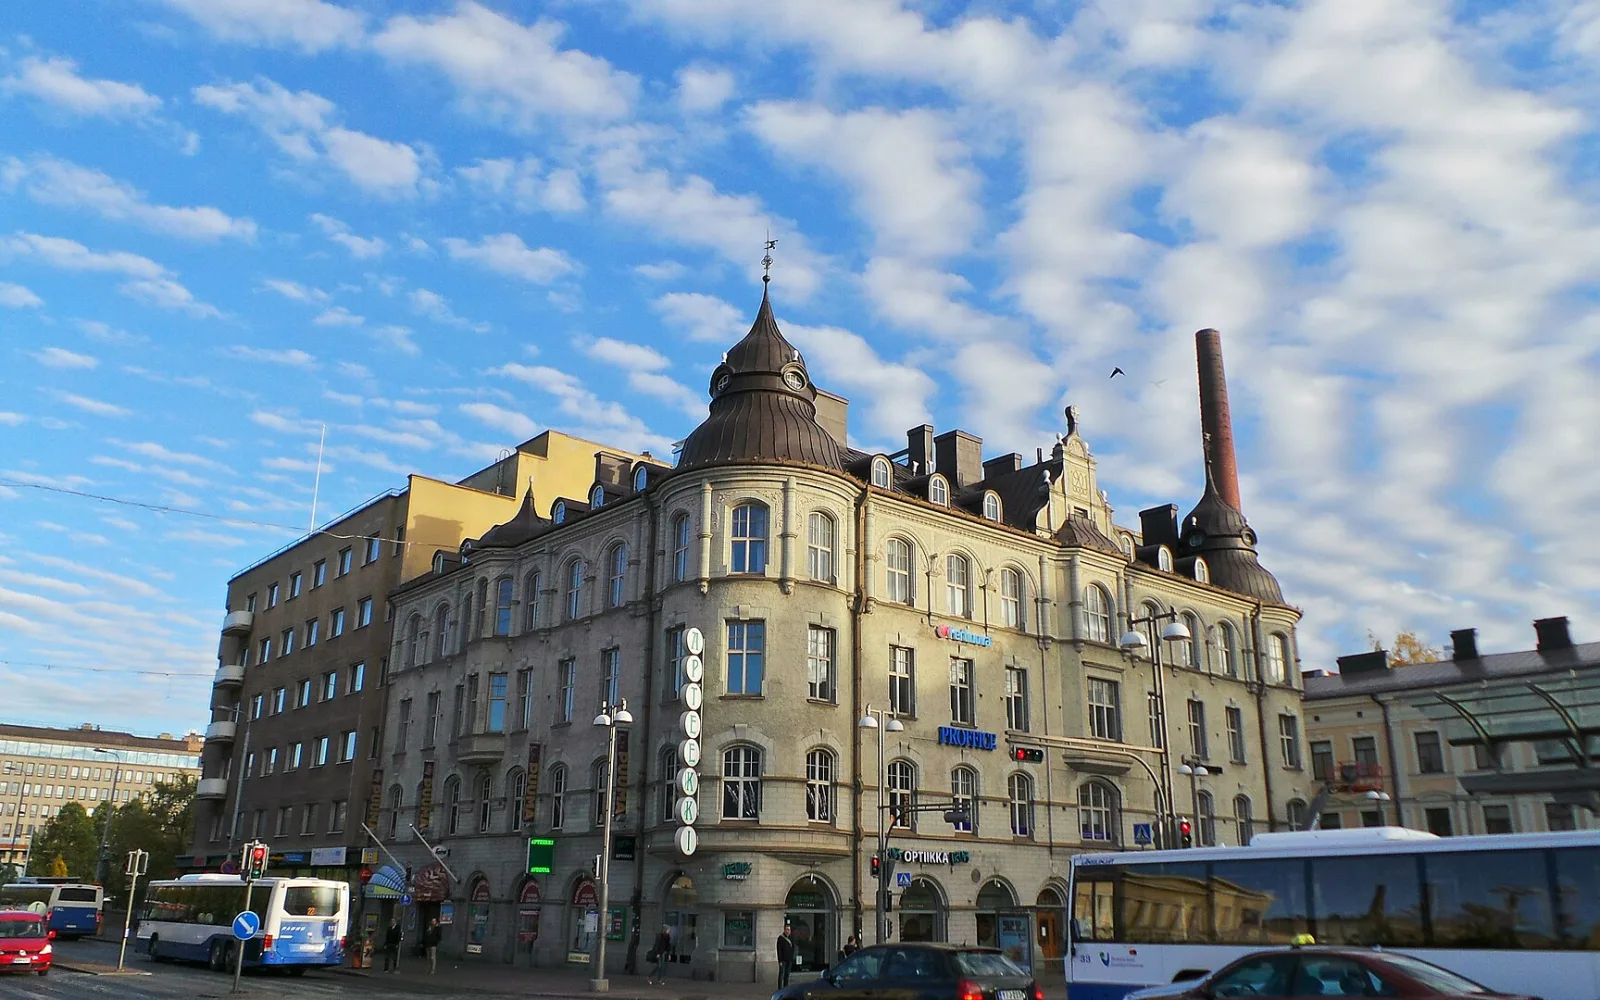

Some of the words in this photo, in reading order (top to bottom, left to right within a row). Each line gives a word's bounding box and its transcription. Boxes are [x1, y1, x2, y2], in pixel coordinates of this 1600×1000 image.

[683, 630, 702, 852] APTEEKKI
[940, 727, 996, 750] PROFFICE
[523, 762, 539, 821] PUUMA
[904, 850, 949, 864] OPTIIKKA
[307, 907, 316, 916] 22
